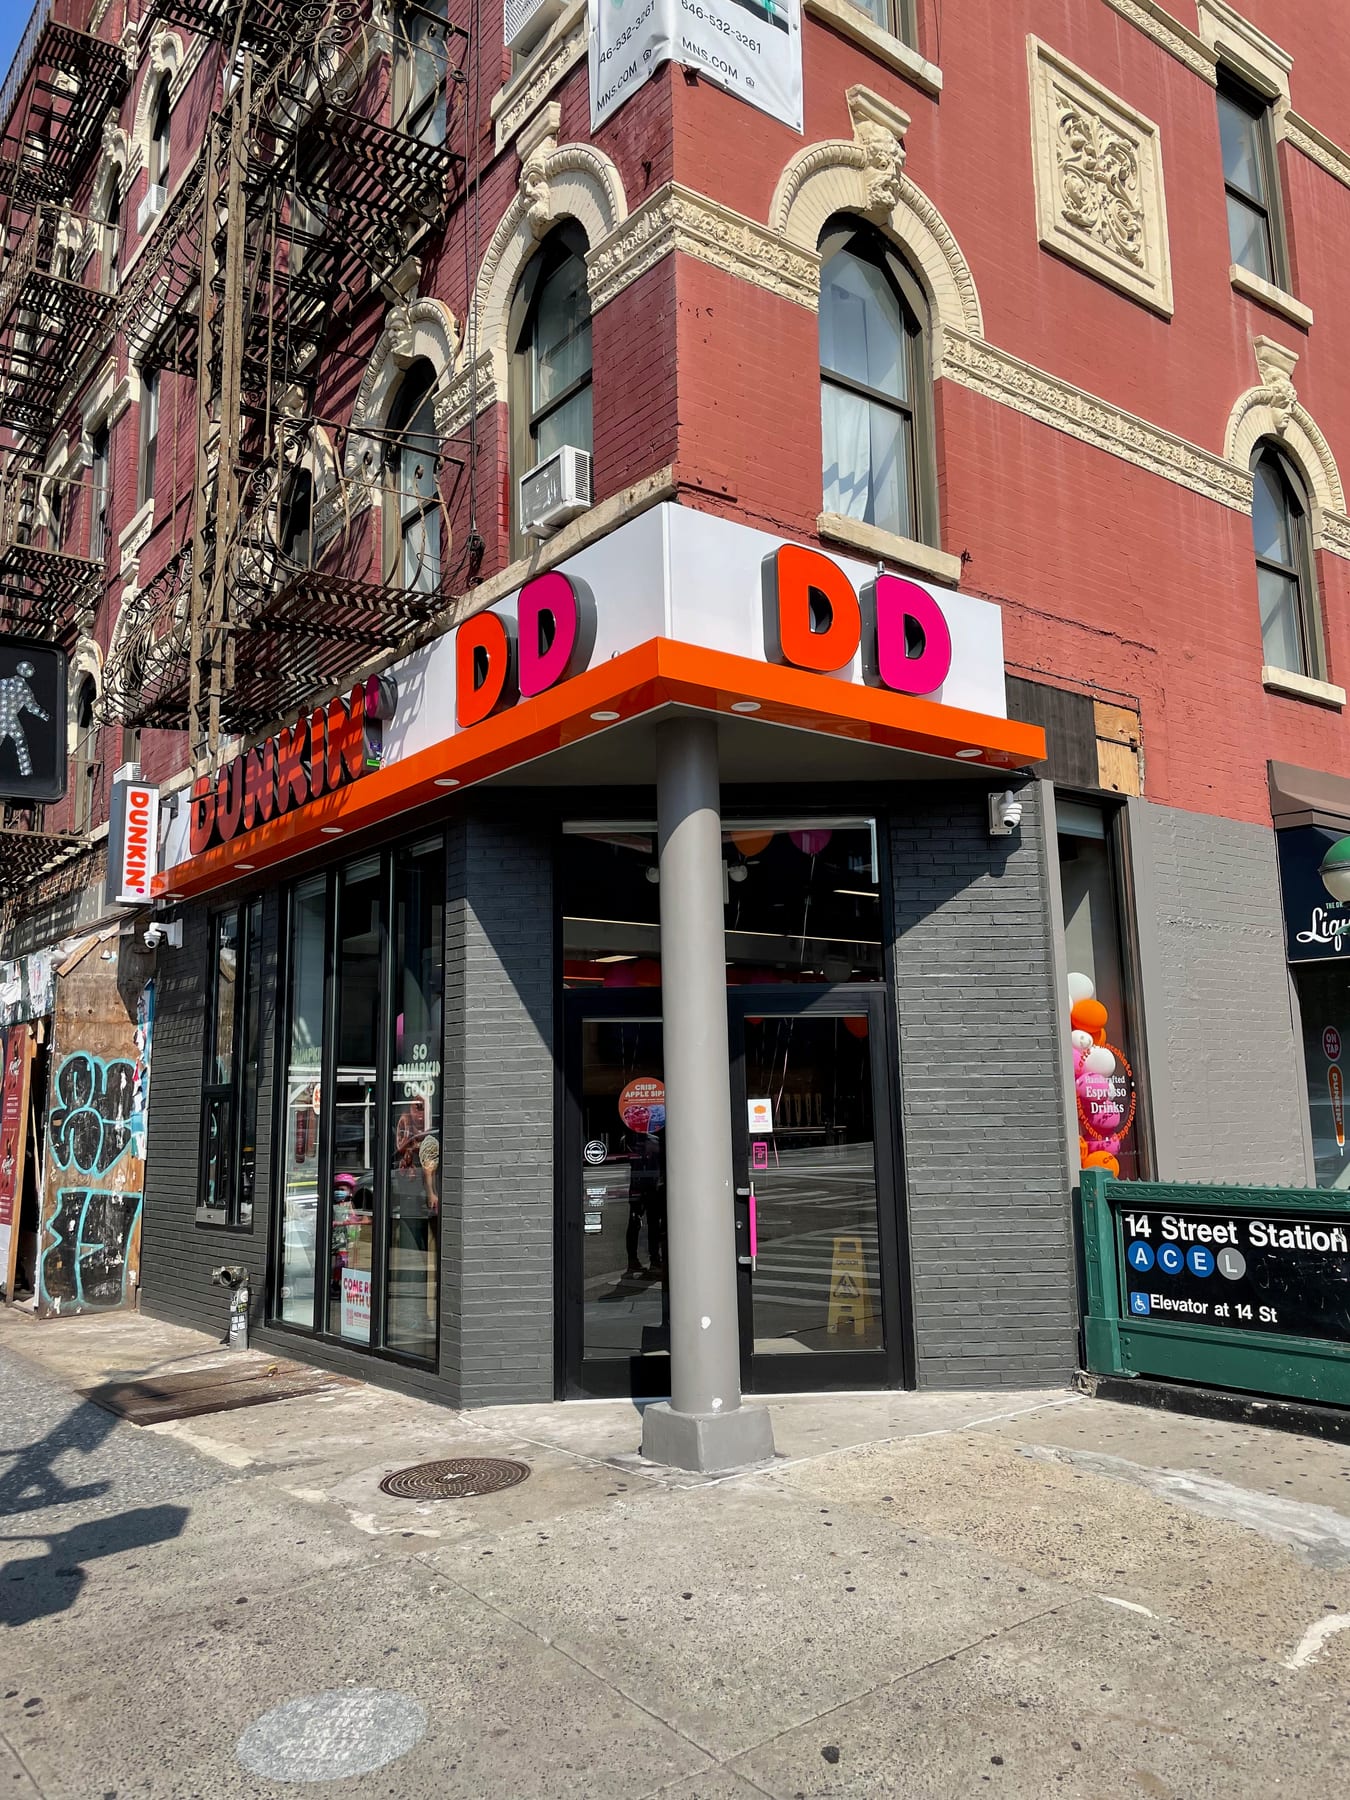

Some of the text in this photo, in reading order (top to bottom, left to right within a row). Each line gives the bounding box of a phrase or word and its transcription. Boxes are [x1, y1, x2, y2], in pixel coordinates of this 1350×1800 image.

[681, 0, 761, 54] 646-532-3261
[682, 36, 739, 80] MNS.COM
[597, 61, 638, 112] MNS.COM
[125, 791, 150, 895] DUNKIN'
[413, 1043, 428, 1060] SO
[404, 1080, 436, 1098] GOOD
[625, 1090, 650, 1098] APPLE
[1086, 1086, 1127, 1099] Espresso
[1091, 1101, 1125, 1114] Drinks
[1125, 1214, 1349, 1253] 14 Street Station
[1135, 1247, 1238, 1273] A C E L
[1150, 1294, 1278, 1323] Elevator at 14 St
